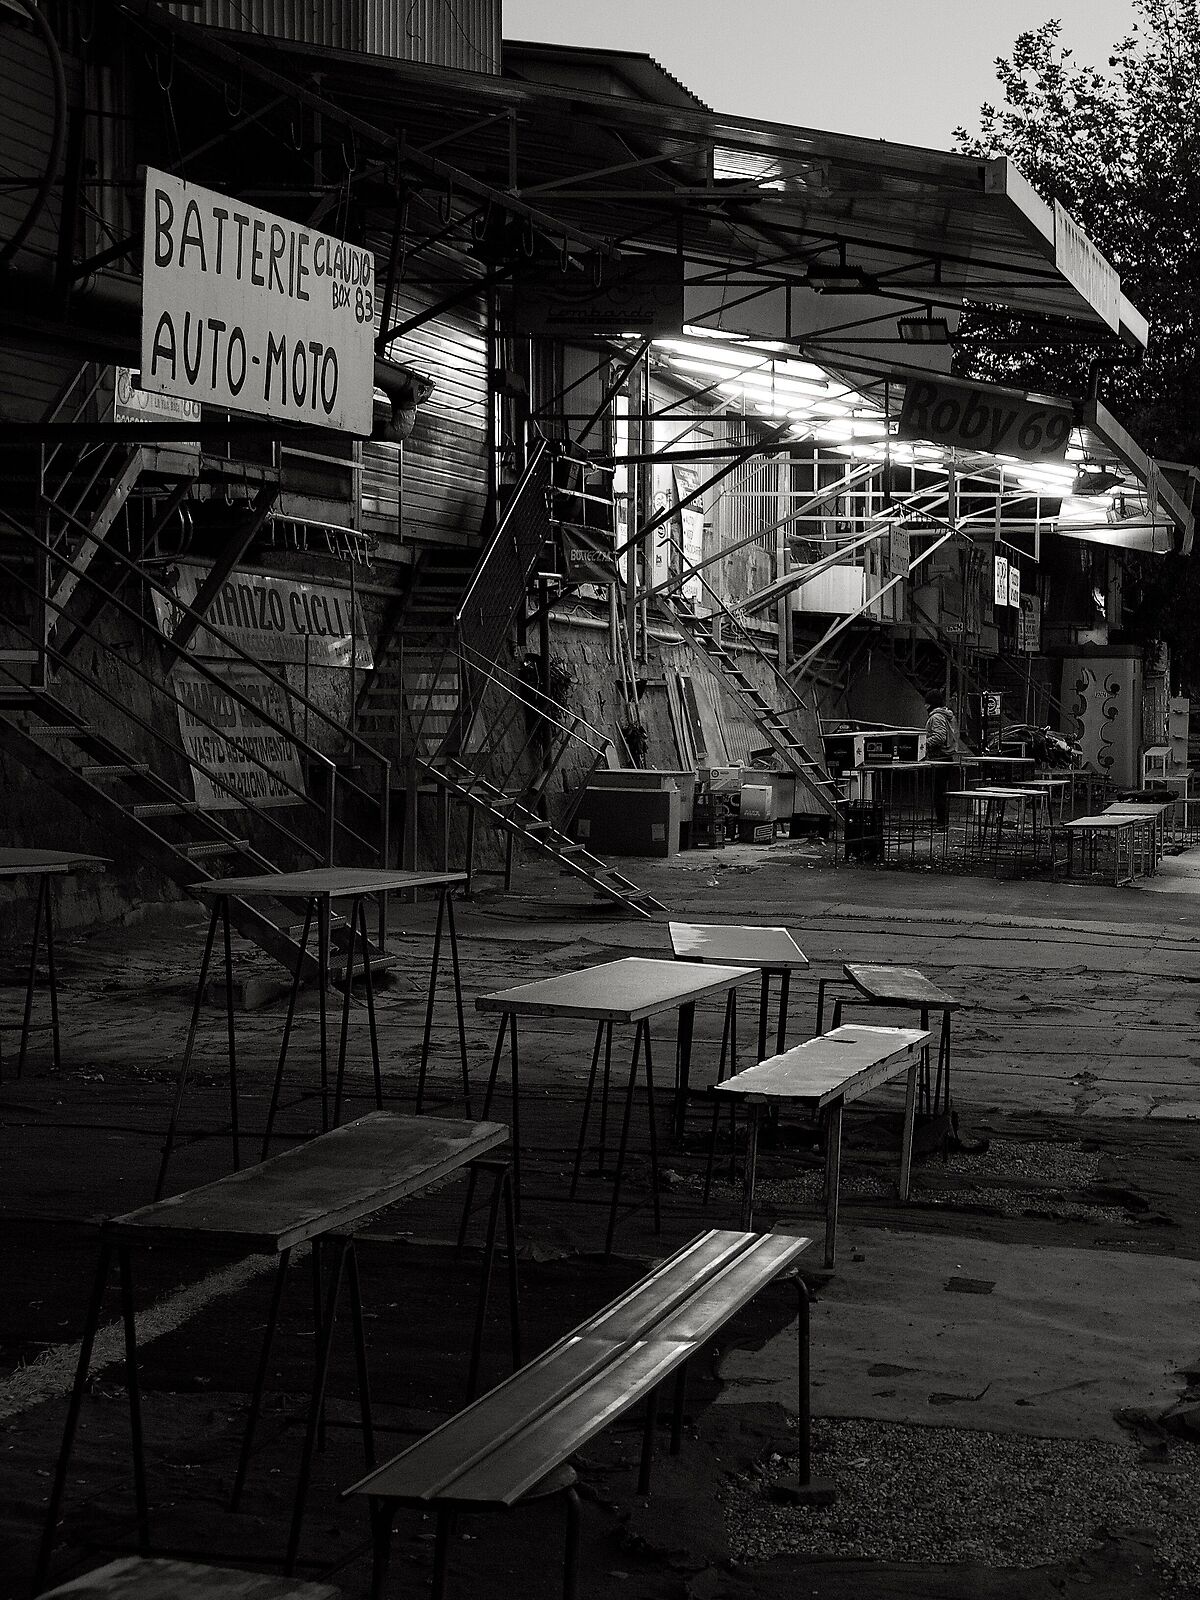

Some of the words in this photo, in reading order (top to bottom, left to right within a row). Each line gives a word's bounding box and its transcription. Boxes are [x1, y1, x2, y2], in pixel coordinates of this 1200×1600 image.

[154, 188, 310, 301] BATTERIE
[313, 237, 371, 287] CLAUDIO
[332, 281, 351, 310] BOX
[355, 286, 373, 324] 83
[151, 310, 338, 415] AUTO-MOTO
[904, 382, 1019, 451] Roby
[1018, 410, 1072, 453] 69
[289, 591, 345, 638] CICLI
